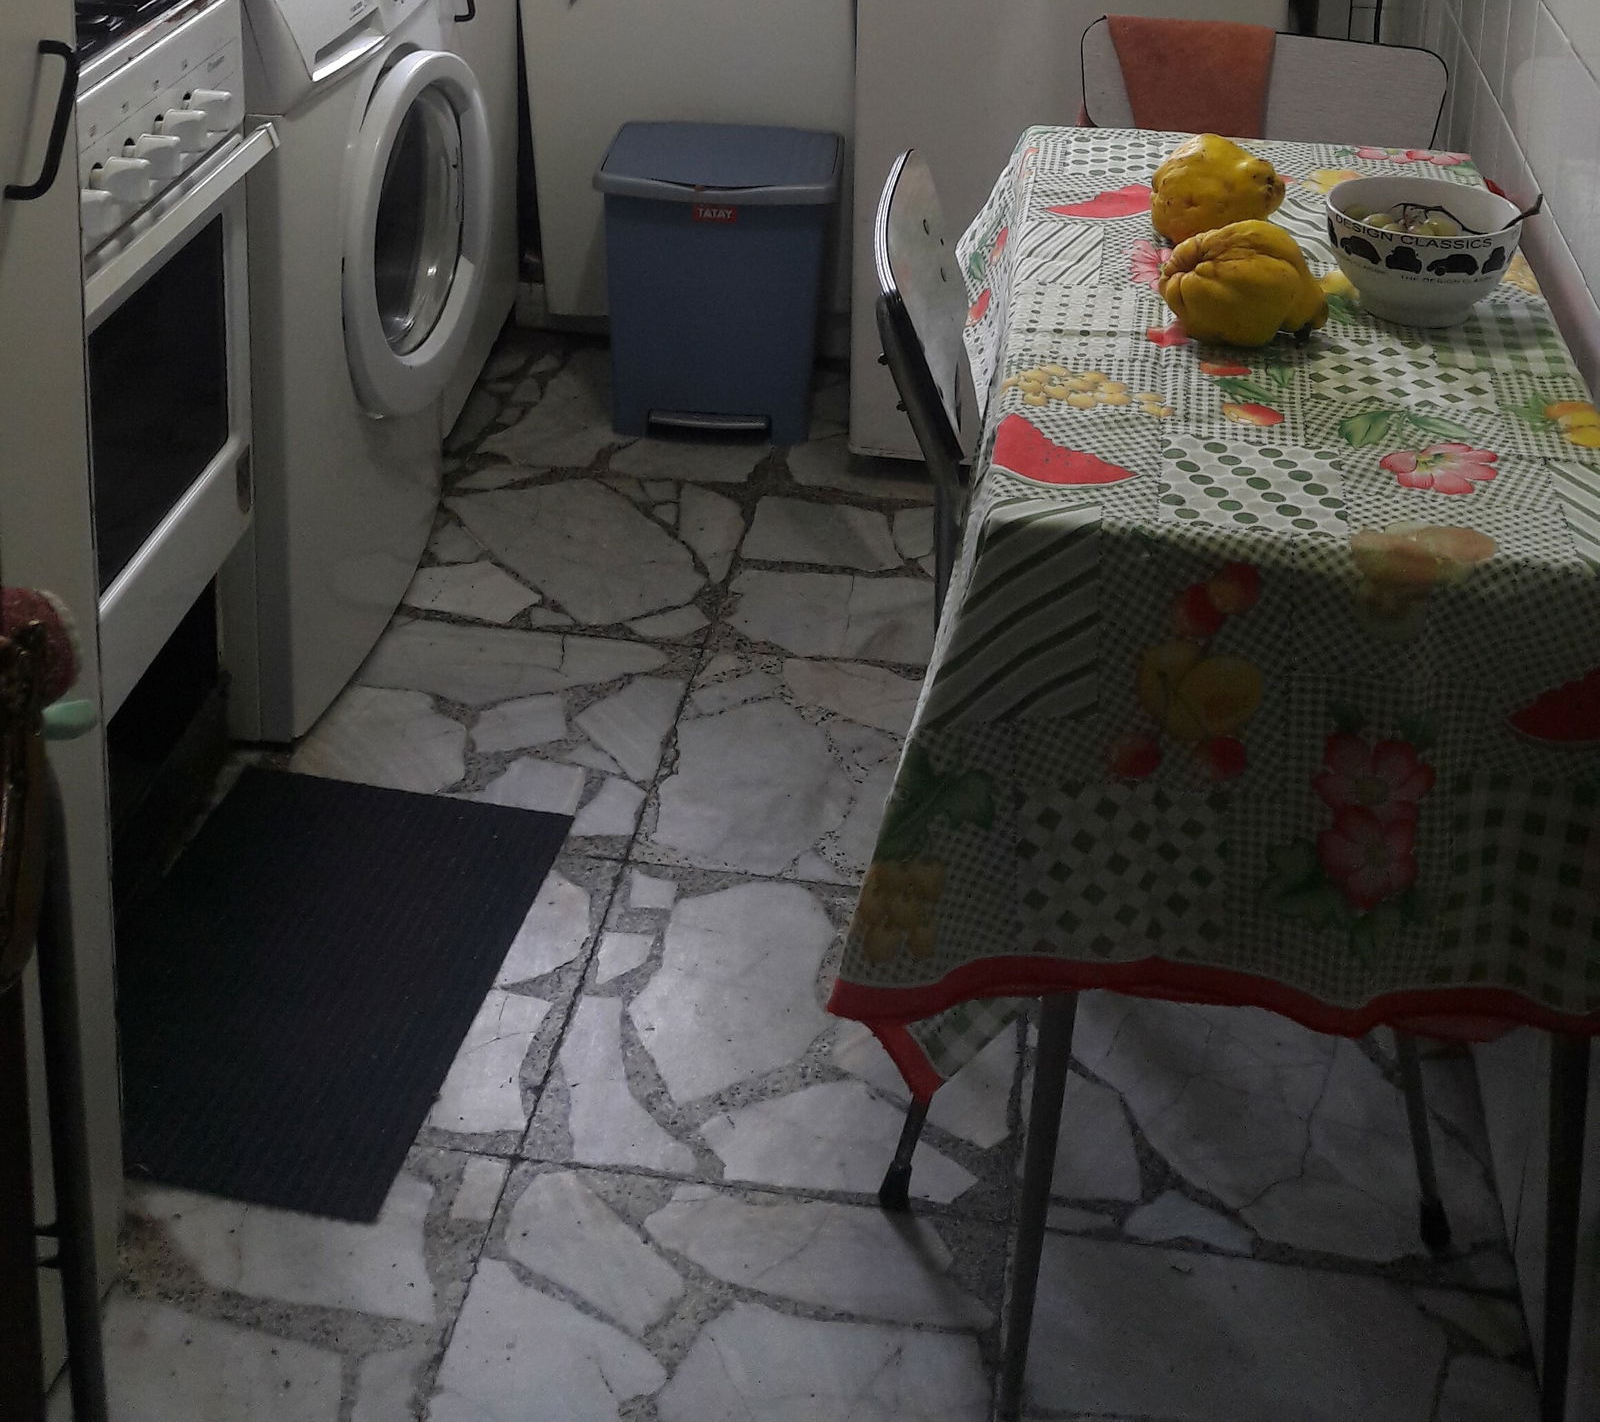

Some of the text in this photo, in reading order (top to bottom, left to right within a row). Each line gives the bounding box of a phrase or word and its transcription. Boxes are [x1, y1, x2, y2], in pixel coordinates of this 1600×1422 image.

[697, 208, 733, 219] TATAY
[1334, 212, 1493, 250] DESIGN CLASSICS
